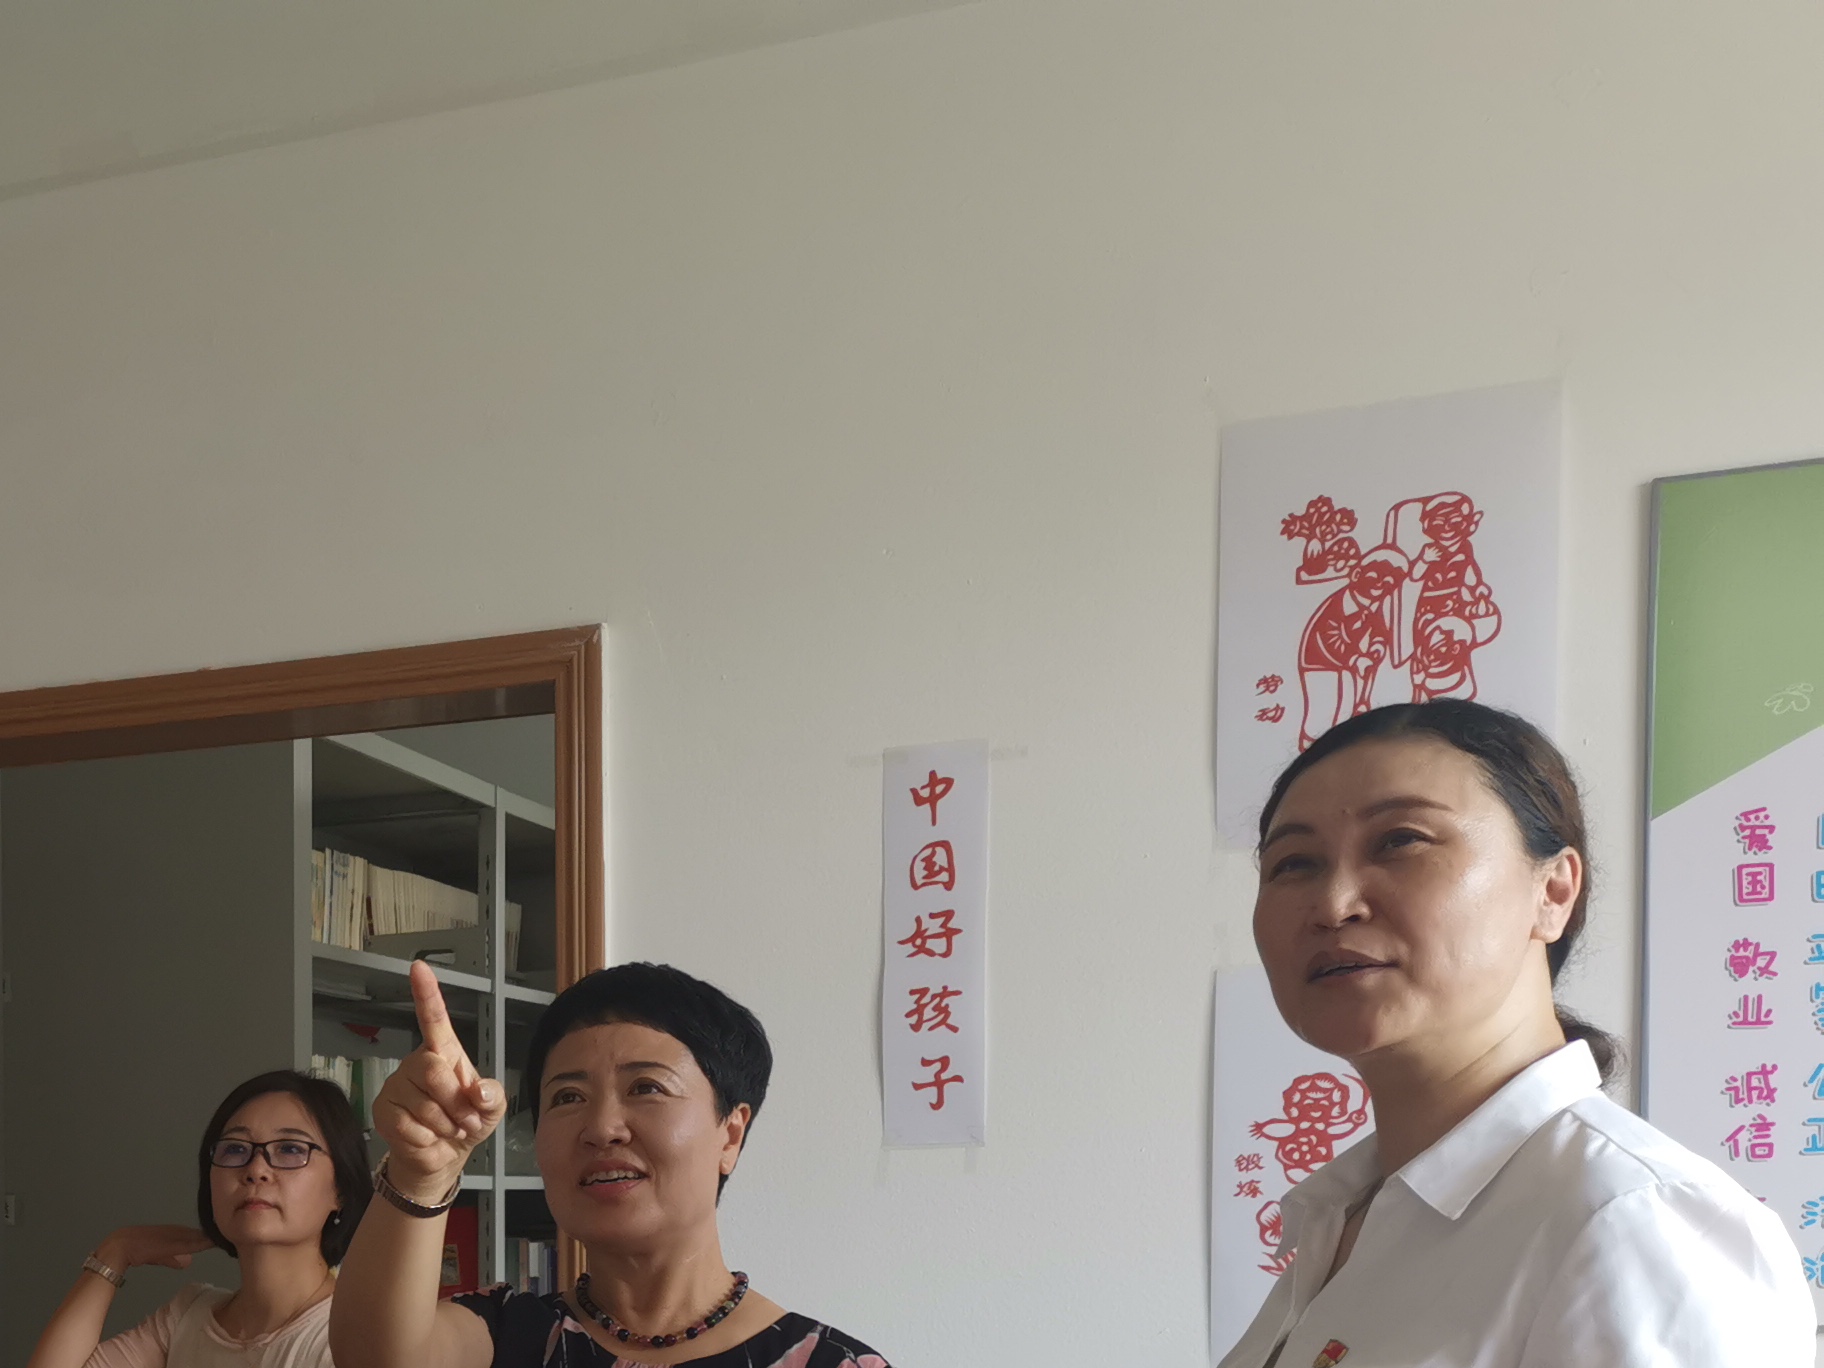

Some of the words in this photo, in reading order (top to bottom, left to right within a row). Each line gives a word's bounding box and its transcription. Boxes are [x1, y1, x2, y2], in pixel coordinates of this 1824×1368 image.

[1254, 673, 1285, 723] 劳动
[1734, 806, 1775, 907] 爱国
[896, 769, 964, 1111] 中国好孩子
[1728, 937, 1778, 1027] 敬业
[1723, 1063, 1778, 1160] 诚信
[1233, 1152, 1266, 1199] 锻炼
